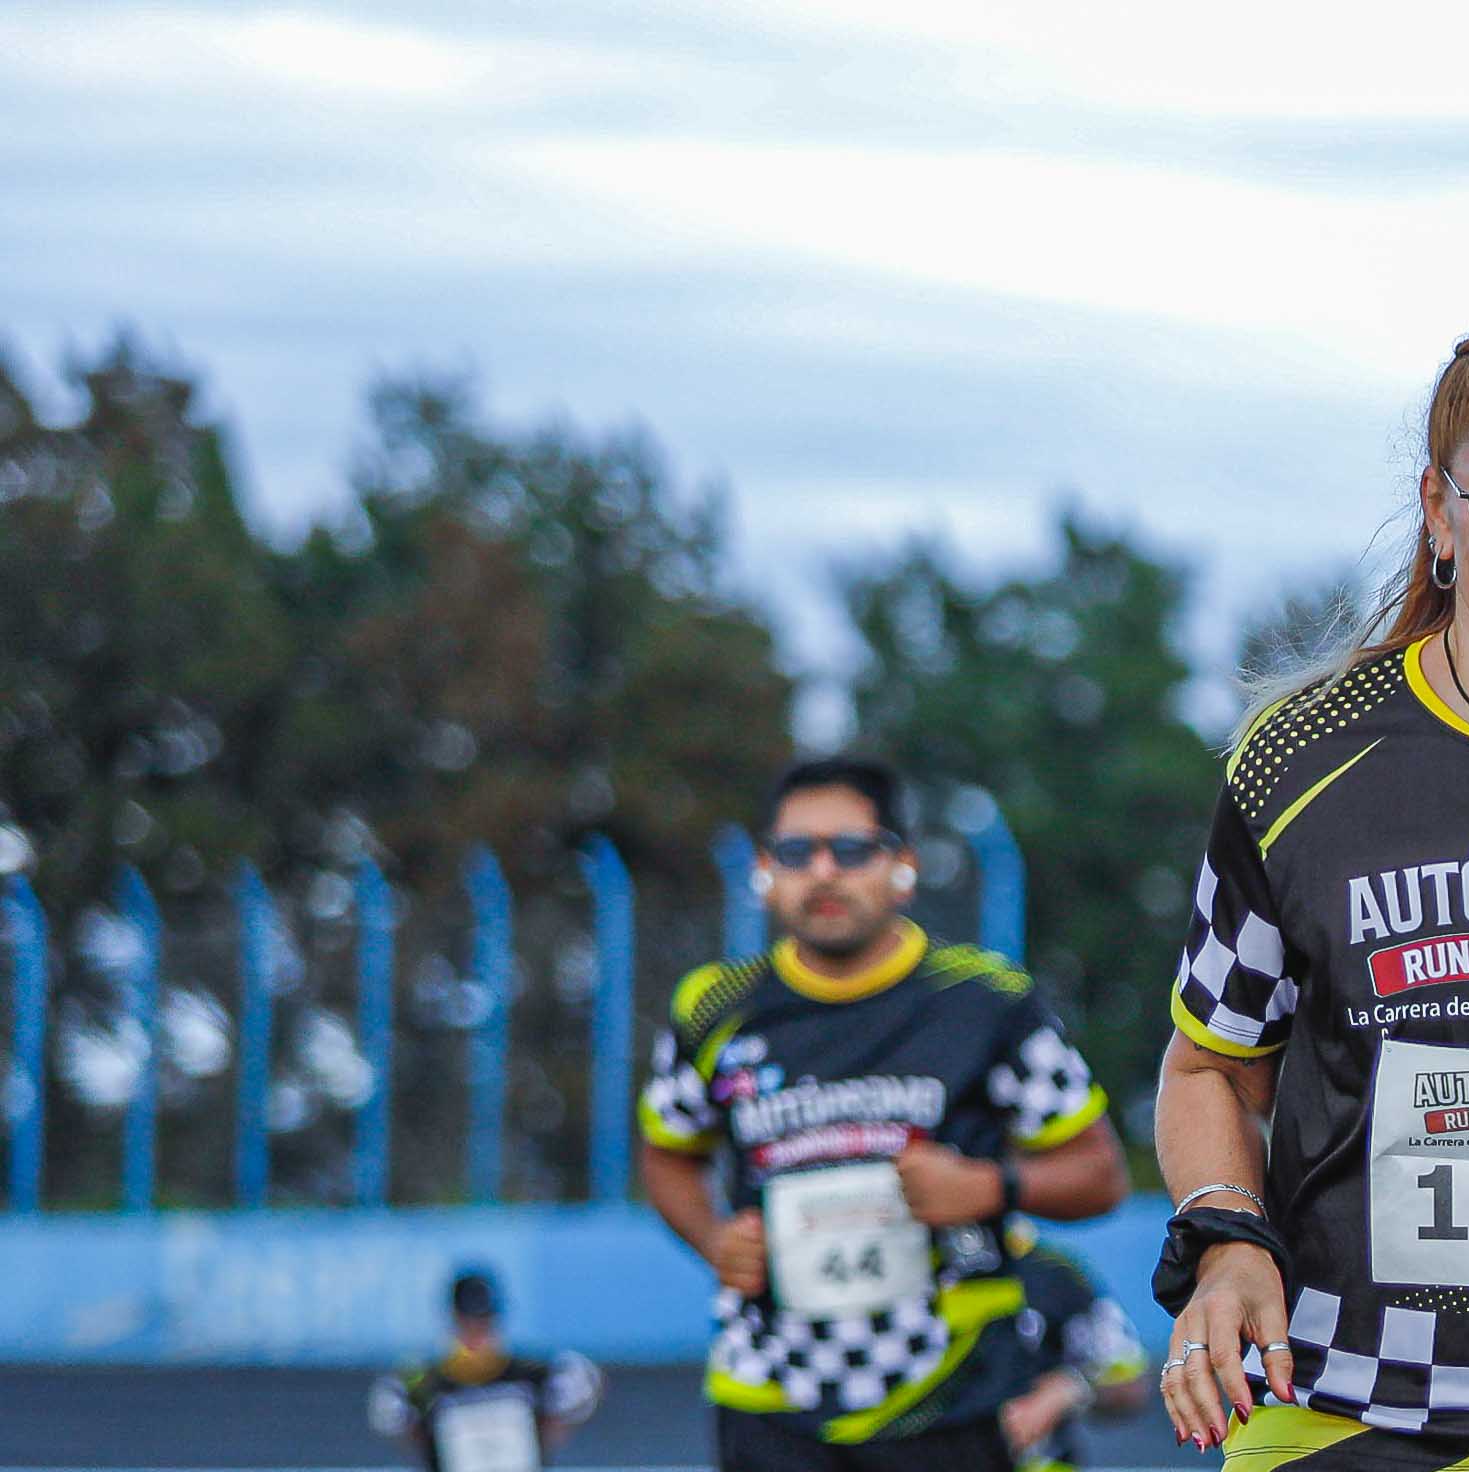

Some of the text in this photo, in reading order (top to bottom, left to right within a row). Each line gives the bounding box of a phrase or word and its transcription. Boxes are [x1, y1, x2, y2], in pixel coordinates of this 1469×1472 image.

[1347, 1007, 1370, 1026] La
[1374, 1002, 1441, 1024] Carrera
[1408, 1136, 1421, 1147] La
[1423, 1136, 1465, 1147] Carrera
